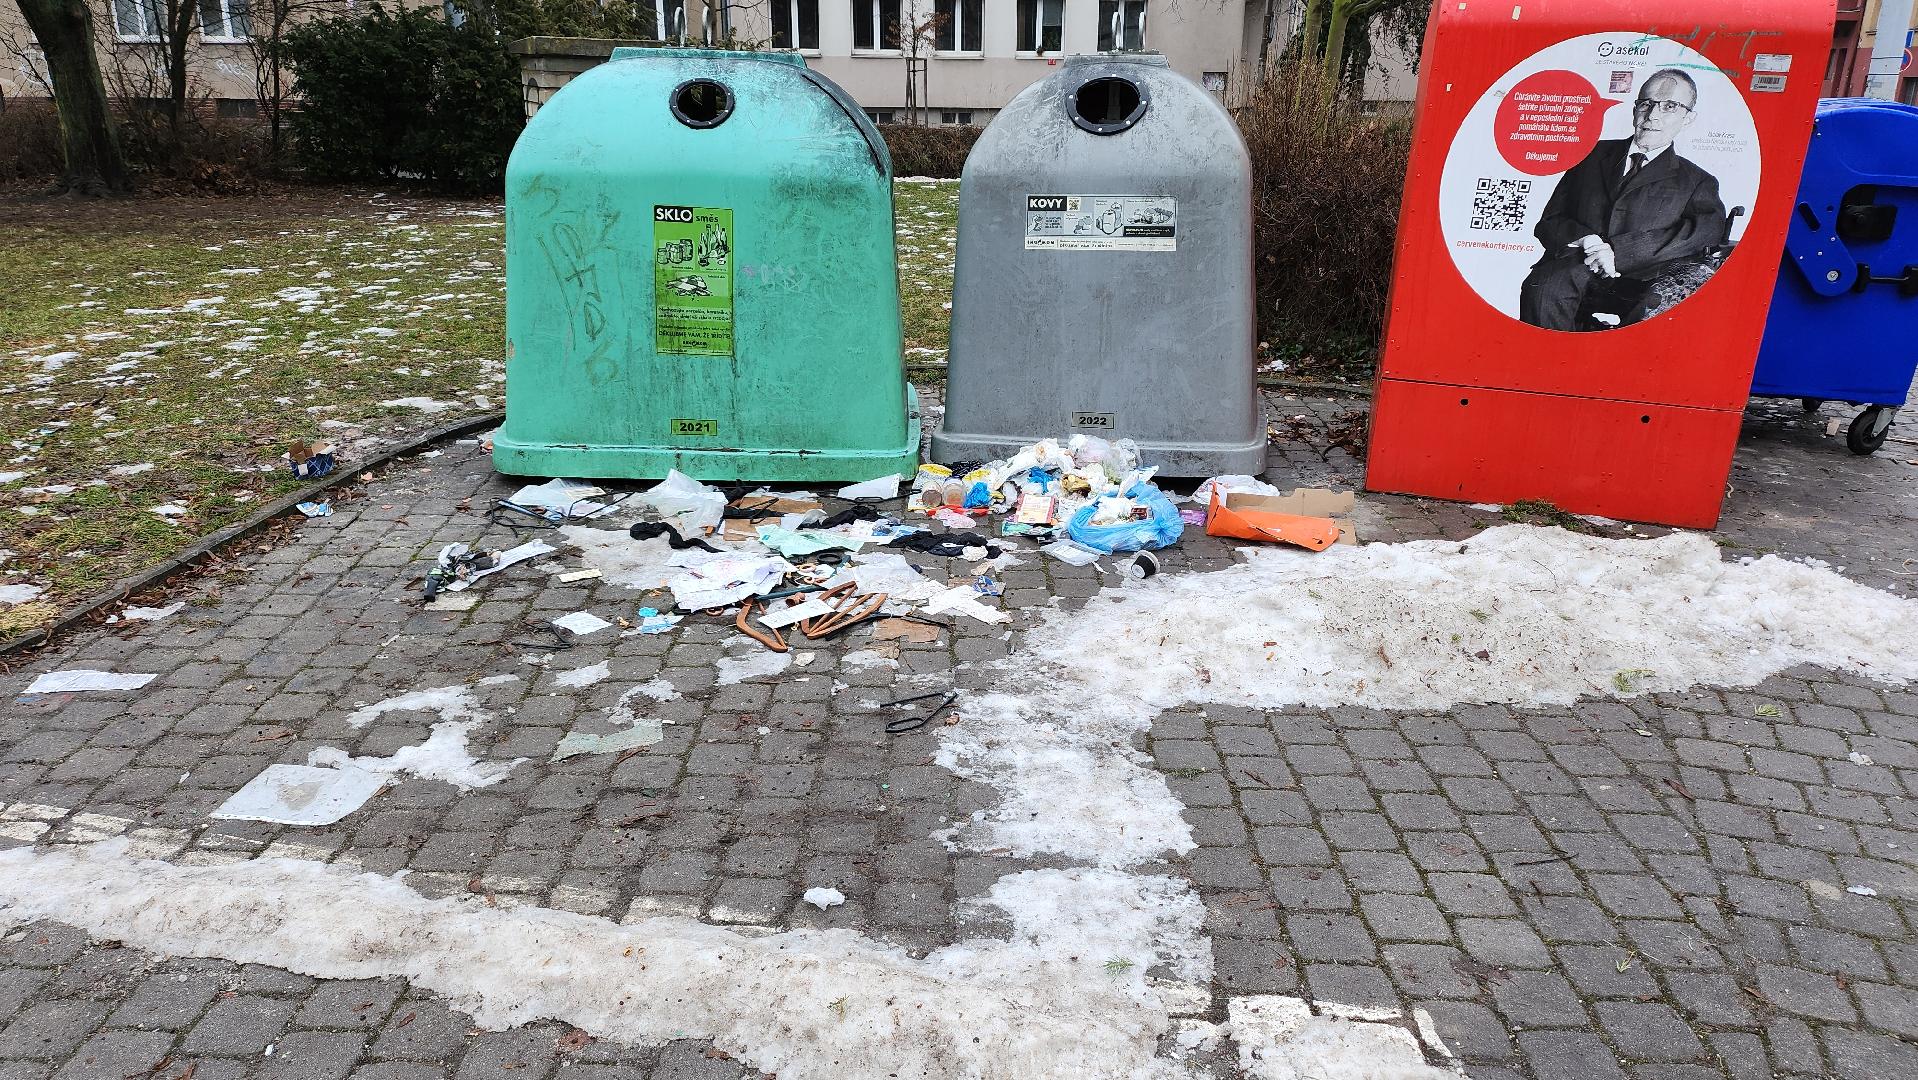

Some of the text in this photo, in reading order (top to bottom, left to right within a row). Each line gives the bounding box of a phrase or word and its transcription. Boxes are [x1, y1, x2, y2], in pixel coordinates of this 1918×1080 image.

[1615, 45, 1650, 56] asekol
[1550, 123, 1568, 132] lidem
[1029, 198, 1064, 209] KOVY
[656, 207, 719, 223] SKLO směs
[1079, 416, 1107, 425] 2022
[679, 422, 710, 432] 2021
